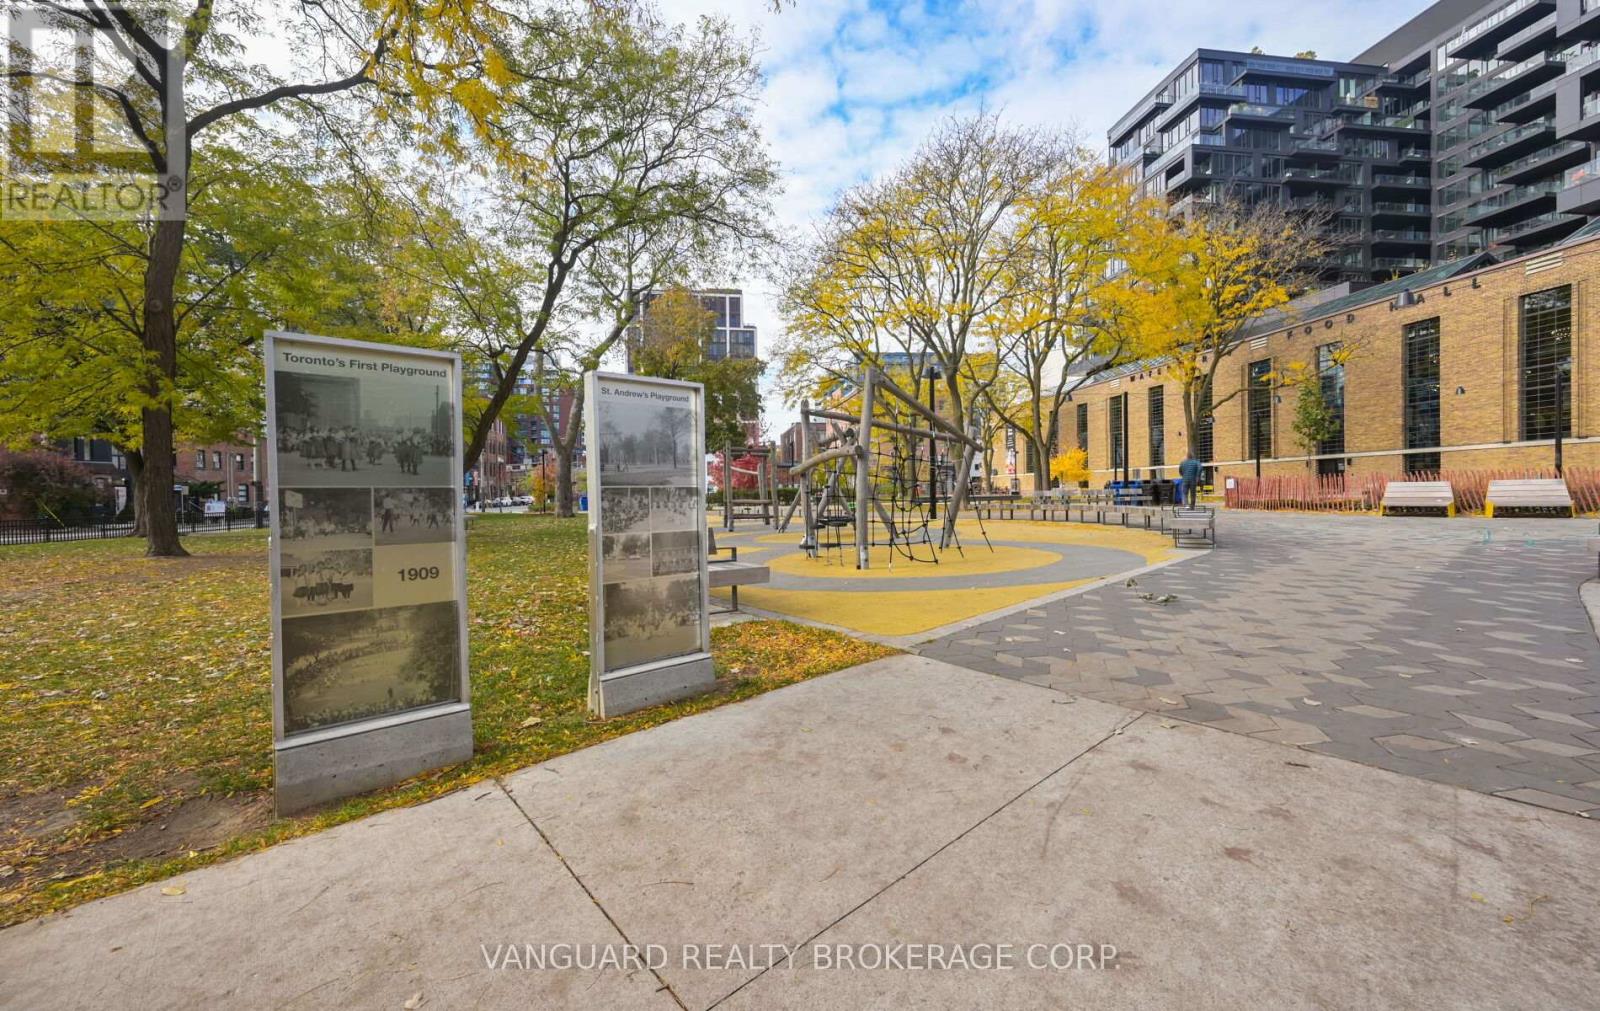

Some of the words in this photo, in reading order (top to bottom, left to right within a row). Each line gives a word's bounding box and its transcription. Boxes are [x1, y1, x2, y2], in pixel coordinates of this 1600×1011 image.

[1286, 313, 1355, 340] FOOD
[283, 352, 345, 368] Toronto's
[350, 359, 378, 372] First
[381, 363, 447, 377] Playground
[601, 386, 613, 396] St.
[614, 388, 649, 399] Andrew's
[650, 391, 689, 403] Playground
[397, 566, 440, 582] 1909
